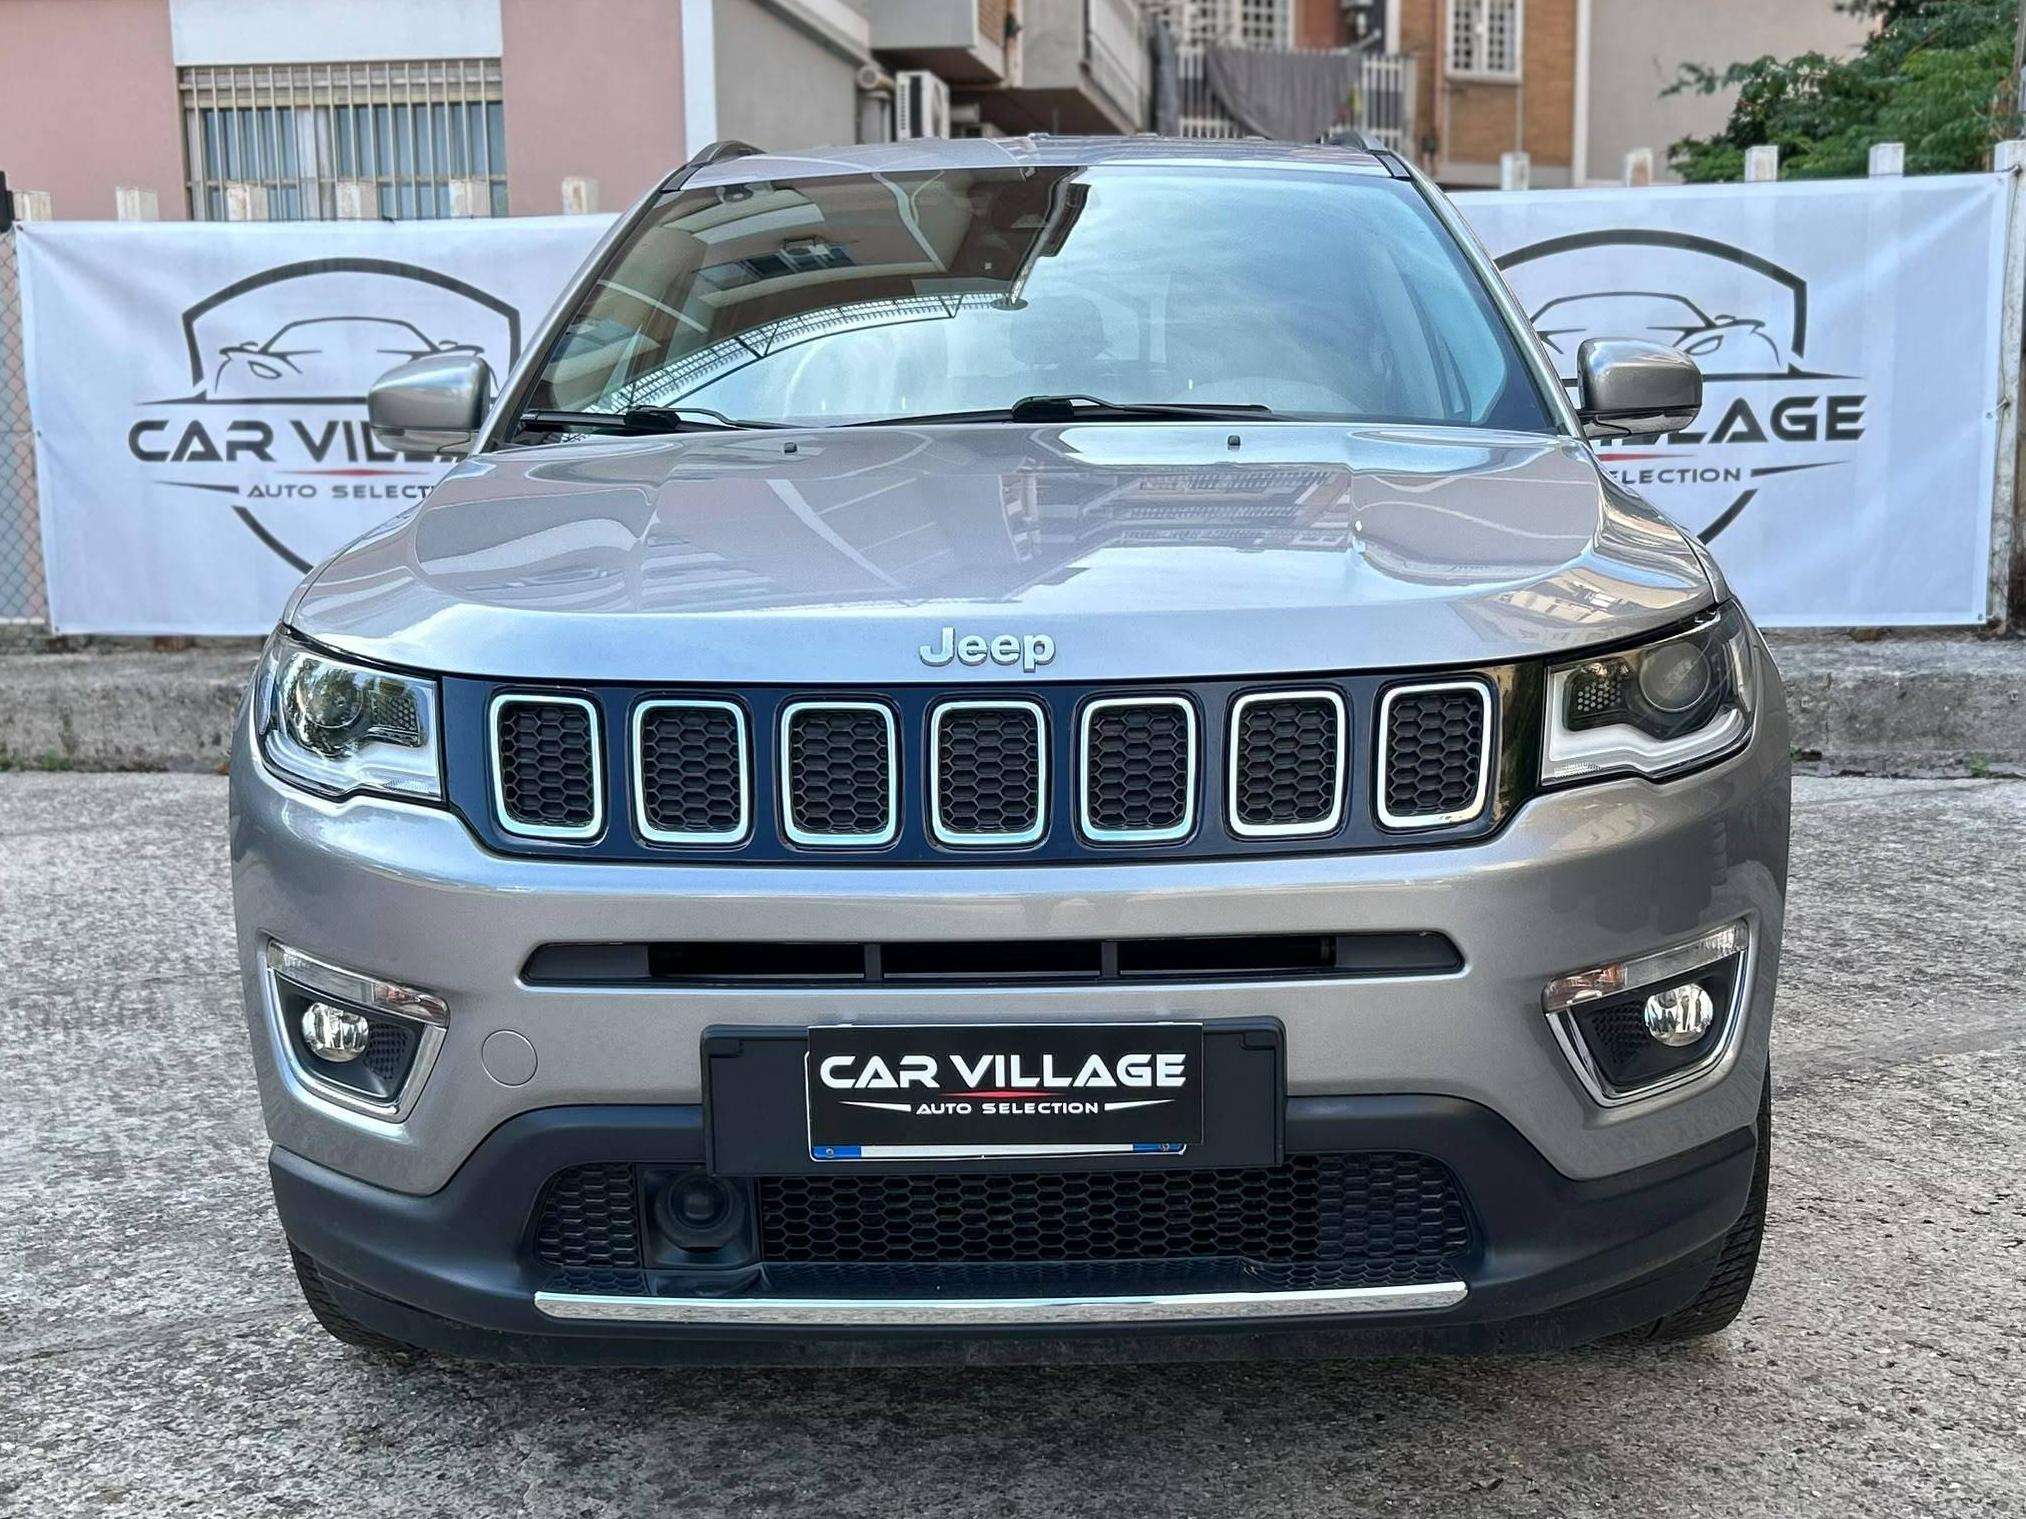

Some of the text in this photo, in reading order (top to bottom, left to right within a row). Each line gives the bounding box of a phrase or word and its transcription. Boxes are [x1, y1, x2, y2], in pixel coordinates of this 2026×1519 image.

[128, 419, 458, 463] CAR VIL
[246, 484, 318, 499] AUTO
[919, 626, 1056, 673] Jeep
[819, 1053, 1187, 1089] CAR VILLAGE
[915, 1101, 1099, 1115] AUTO SELECTION
